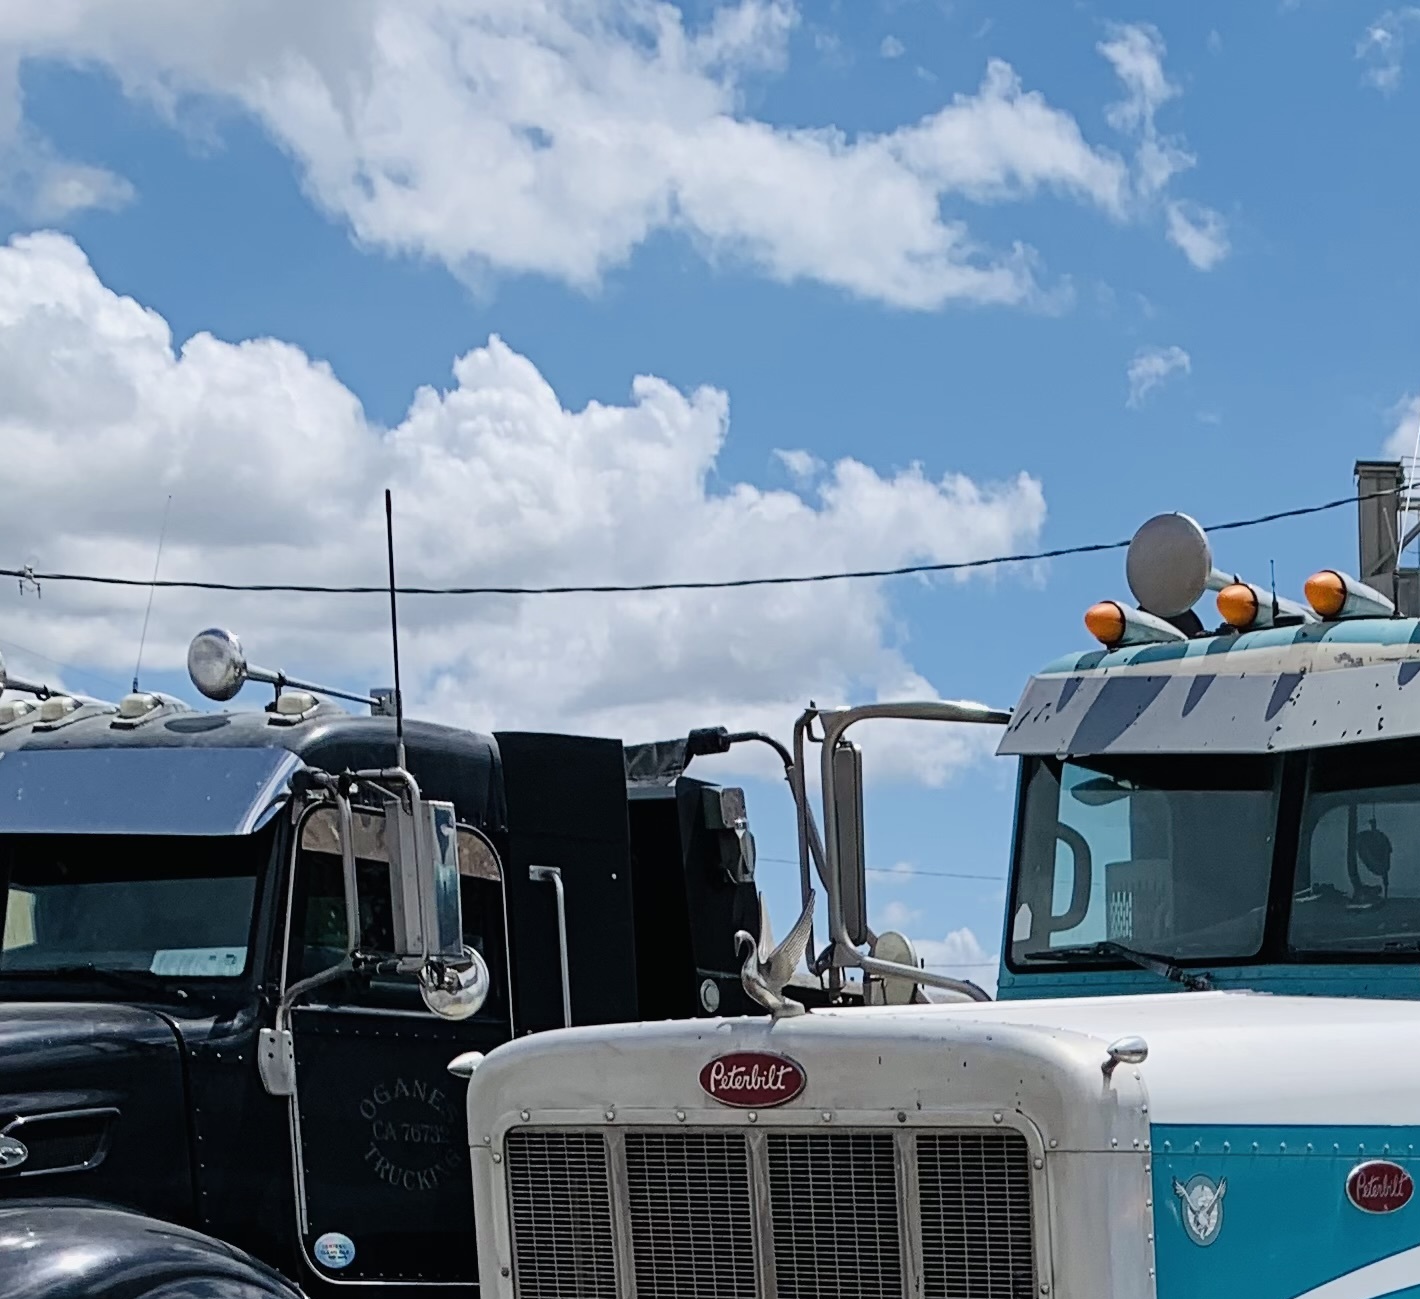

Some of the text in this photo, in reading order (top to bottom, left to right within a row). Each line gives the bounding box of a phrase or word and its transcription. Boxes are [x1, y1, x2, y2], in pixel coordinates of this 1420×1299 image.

[709, 1061, 793, 1092] Peterbilt
[372, 1120, 397, 1141] CA
[1356, 1171, 1409, 1201] Peterbilt
